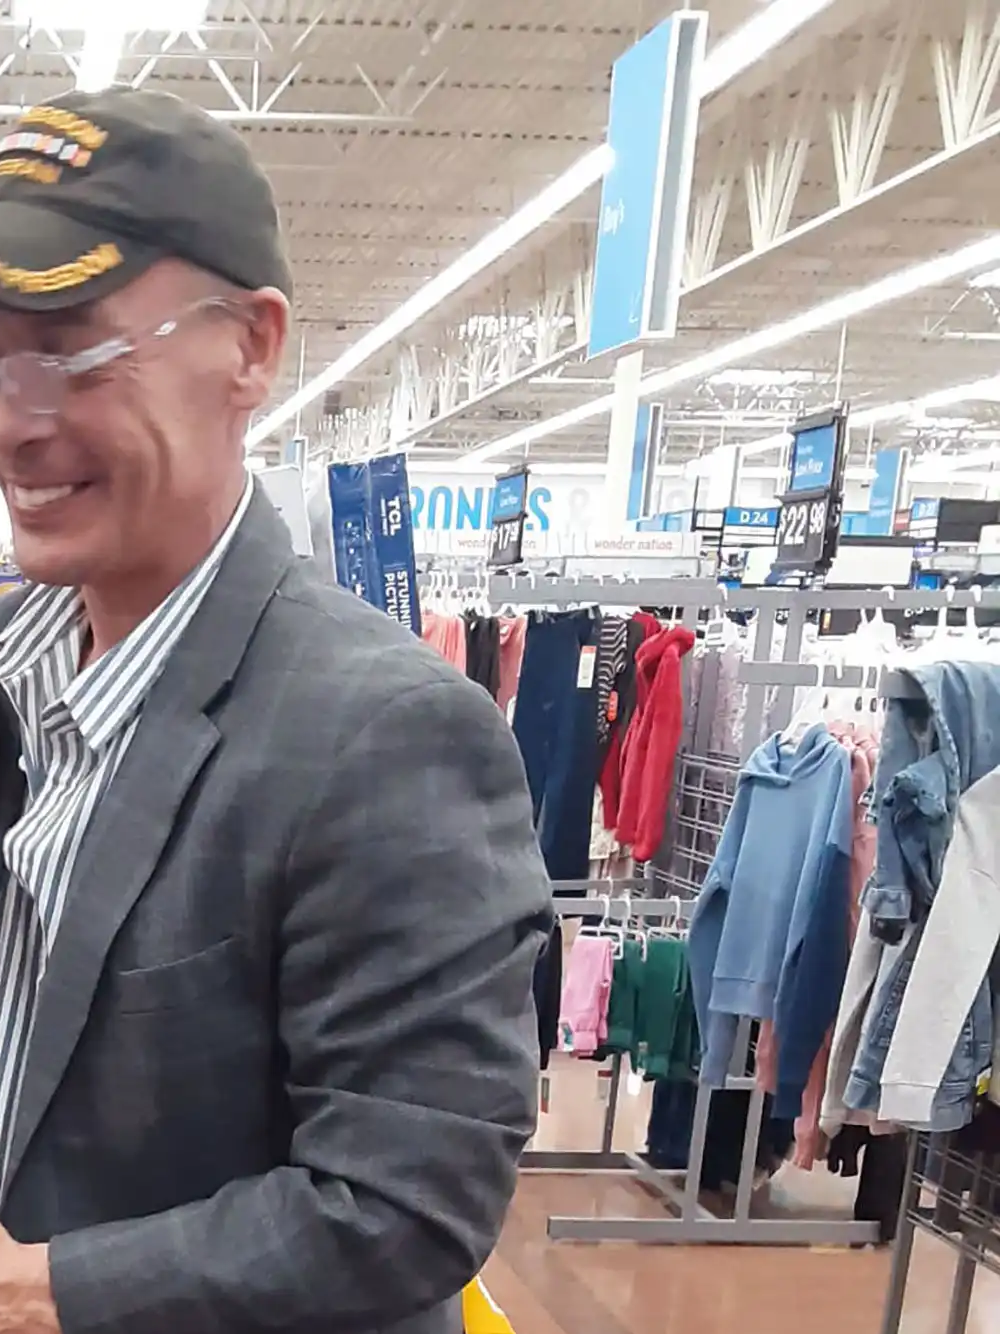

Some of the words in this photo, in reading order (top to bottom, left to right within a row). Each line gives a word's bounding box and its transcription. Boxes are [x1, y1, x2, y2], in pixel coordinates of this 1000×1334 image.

[387, 496, 402, 536] TCL
[740, 511, 750, 523] D
[753, 512, 768, 525] 24
[594, 537, 635, 550] wonder
[637, 538, 673, 550] nation
